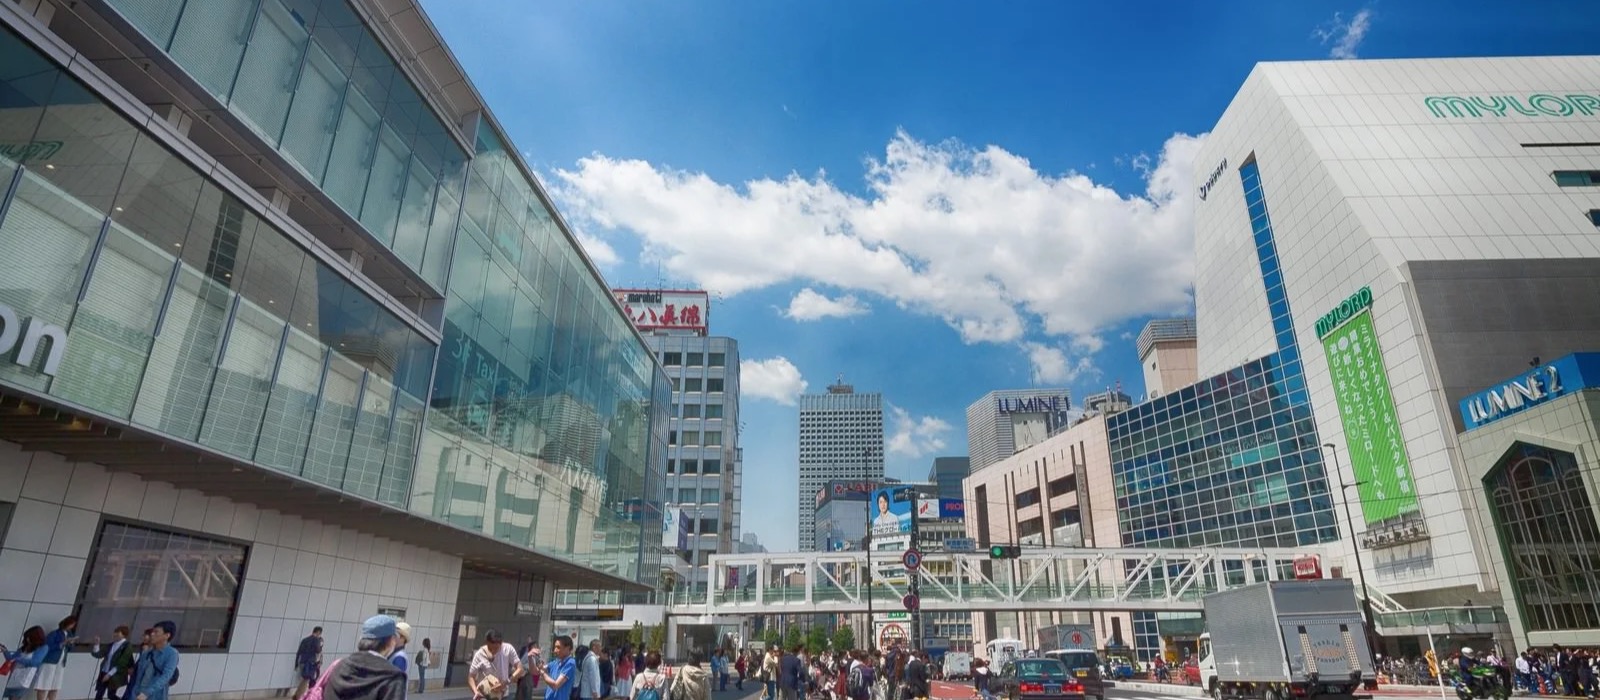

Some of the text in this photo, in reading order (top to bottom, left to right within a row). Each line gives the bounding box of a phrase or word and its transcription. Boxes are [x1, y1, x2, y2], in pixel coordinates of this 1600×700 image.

[1314, 286, 1372, 339] MYLORD
[998, 396, 1059, 412] LUMINE
[1468, 365, 1564, 423] LUMINE 2
